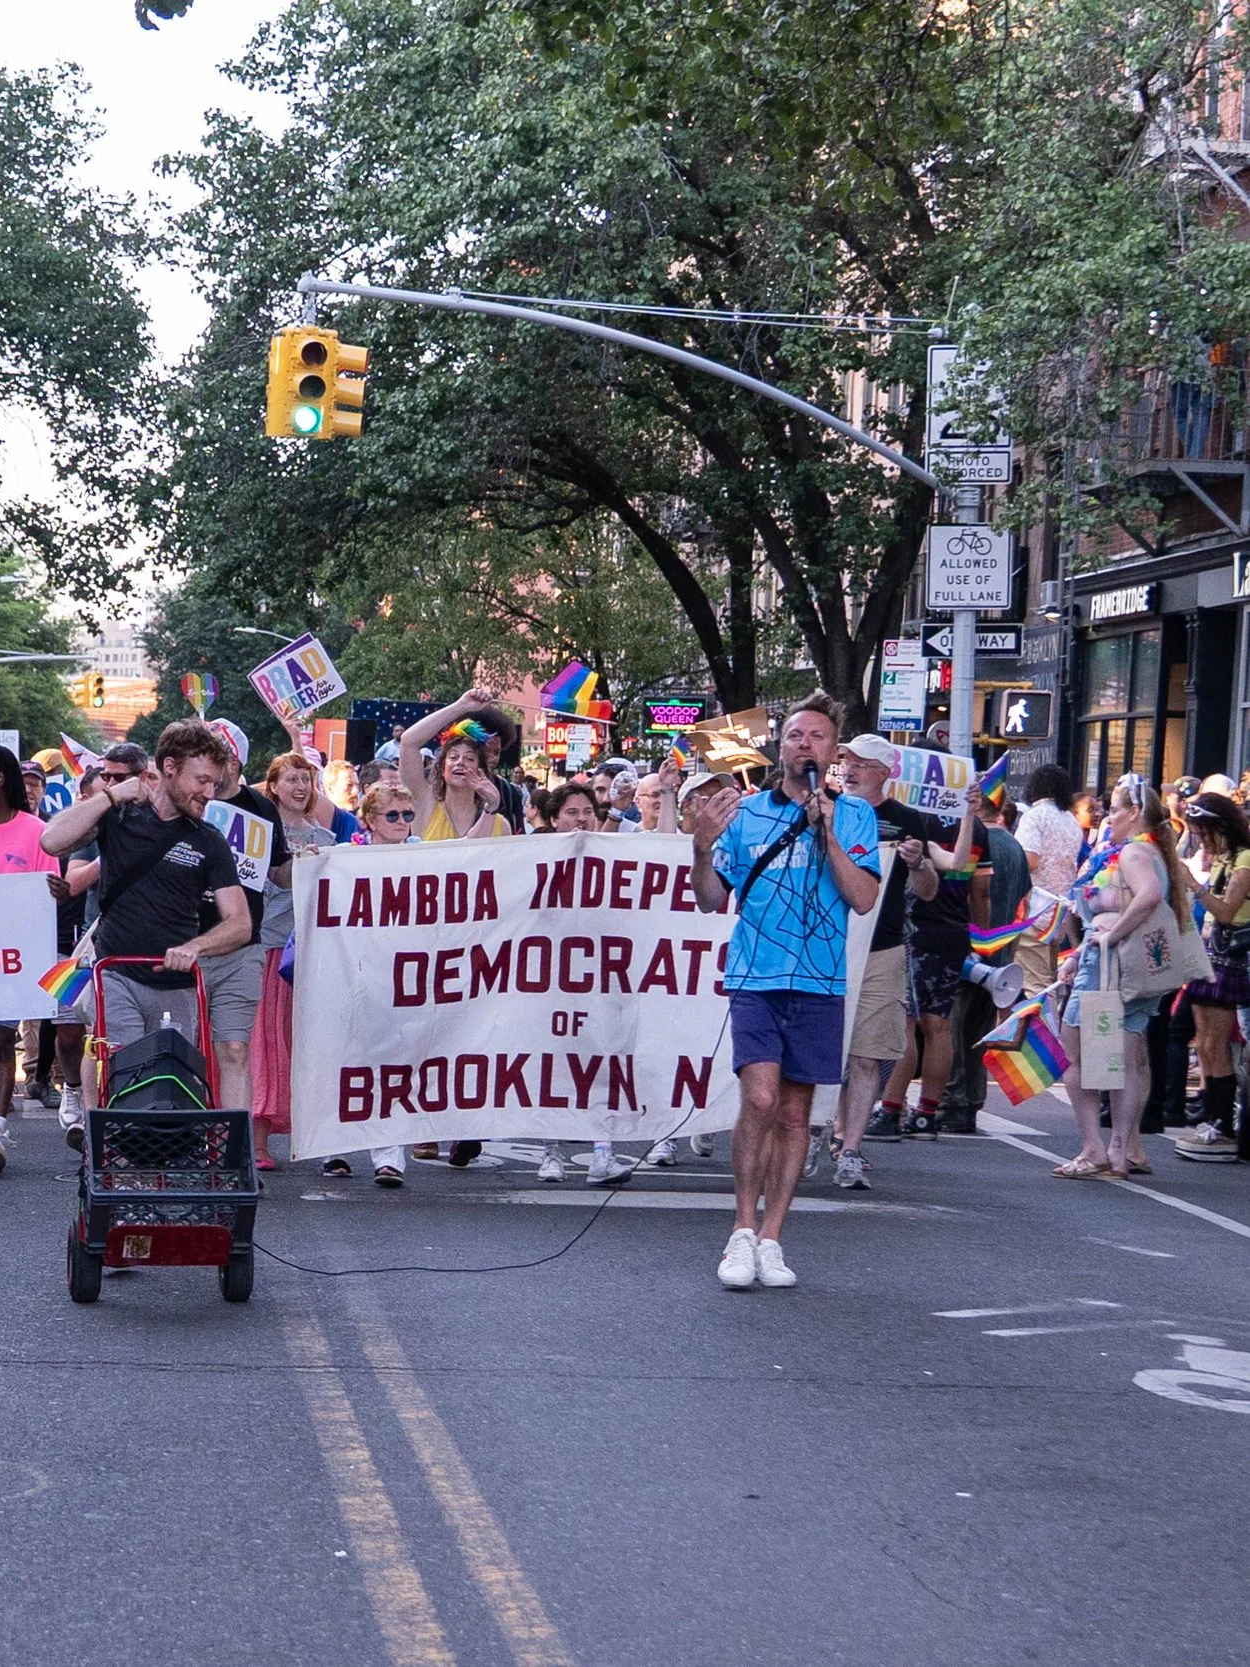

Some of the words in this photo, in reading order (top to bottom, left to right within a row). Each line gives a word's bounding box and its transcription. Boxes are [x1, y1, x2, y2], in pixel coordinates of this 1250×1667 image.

[947, 455, 990, 466] PHOTO
[940, 558, 998, 569] ALLOWED
[946, 575, 970, 585] USE
[975, 575, 991, 585] OF
[934, 591, 965, 601] FULL
[970, 591, 1002, 601] LANE
[1090, 585, 1149, 620] FRAMEBRIDGE
[978, 635, 1009, 647] WAY
[257, 647, 327, 705] BRAD
[650, 706, 700, 716] VOODOO
[654, 714, 694, 724] QUEEN
[887, 780, 939, 809] ANDER
[207, 804, 266, 860] RAD
[238, 858, 256, 869] for
[238, 867, 259, 880] nyc
[316, 869, 498, 928] LAMBDA
[529, 856, 728, 914] INDEPE
[551, 1010, 588, 1037] OF
[338, 1052, 647, 1123] BROOKLYN,
